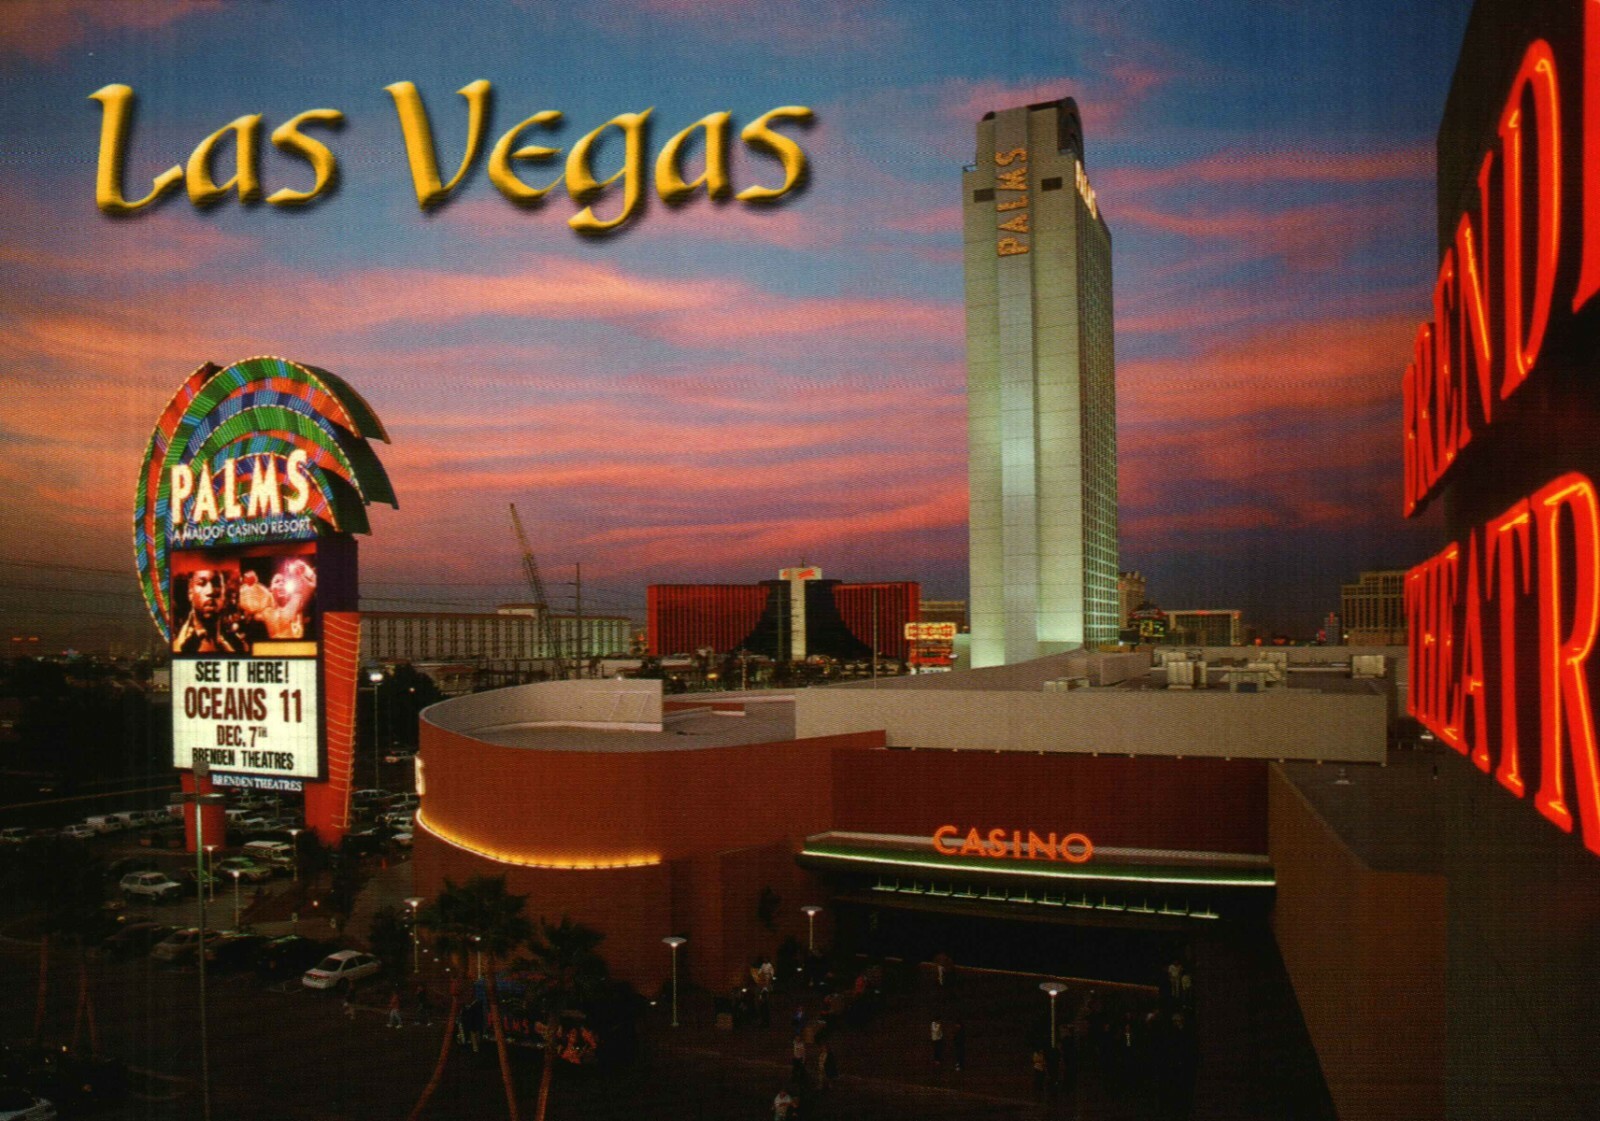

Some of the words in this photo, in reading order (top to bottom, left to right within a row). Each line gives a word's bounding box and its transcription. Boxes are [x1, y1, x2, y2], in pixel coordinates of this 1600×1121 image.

[995, 148, 1029, 257] PALMS
[171, 449, 309, 525] PALMS
[182, 524, 225, 541] MALOOF
[227, 521, 268, 537] CASINO
[270, 516, 311, 533] RESORT
[195, 661, 221, 682] SEE
[227, 662, 240, 683] IT
[247, 662, 289, 684] HERE!
[184, 687, 267, 721] OCEANS
[279, 689, 302, 723] 11
[216, 725, 246, 747] DEC.
[192, 747, 236, 766] BRENDEN
[241, 750, 294, 770] THEATRES
[212, 774, 254, 788] BRENDEN
[254, 777, 303, 792] THEATRES
[932, 825, 1094, 864] CASINO
